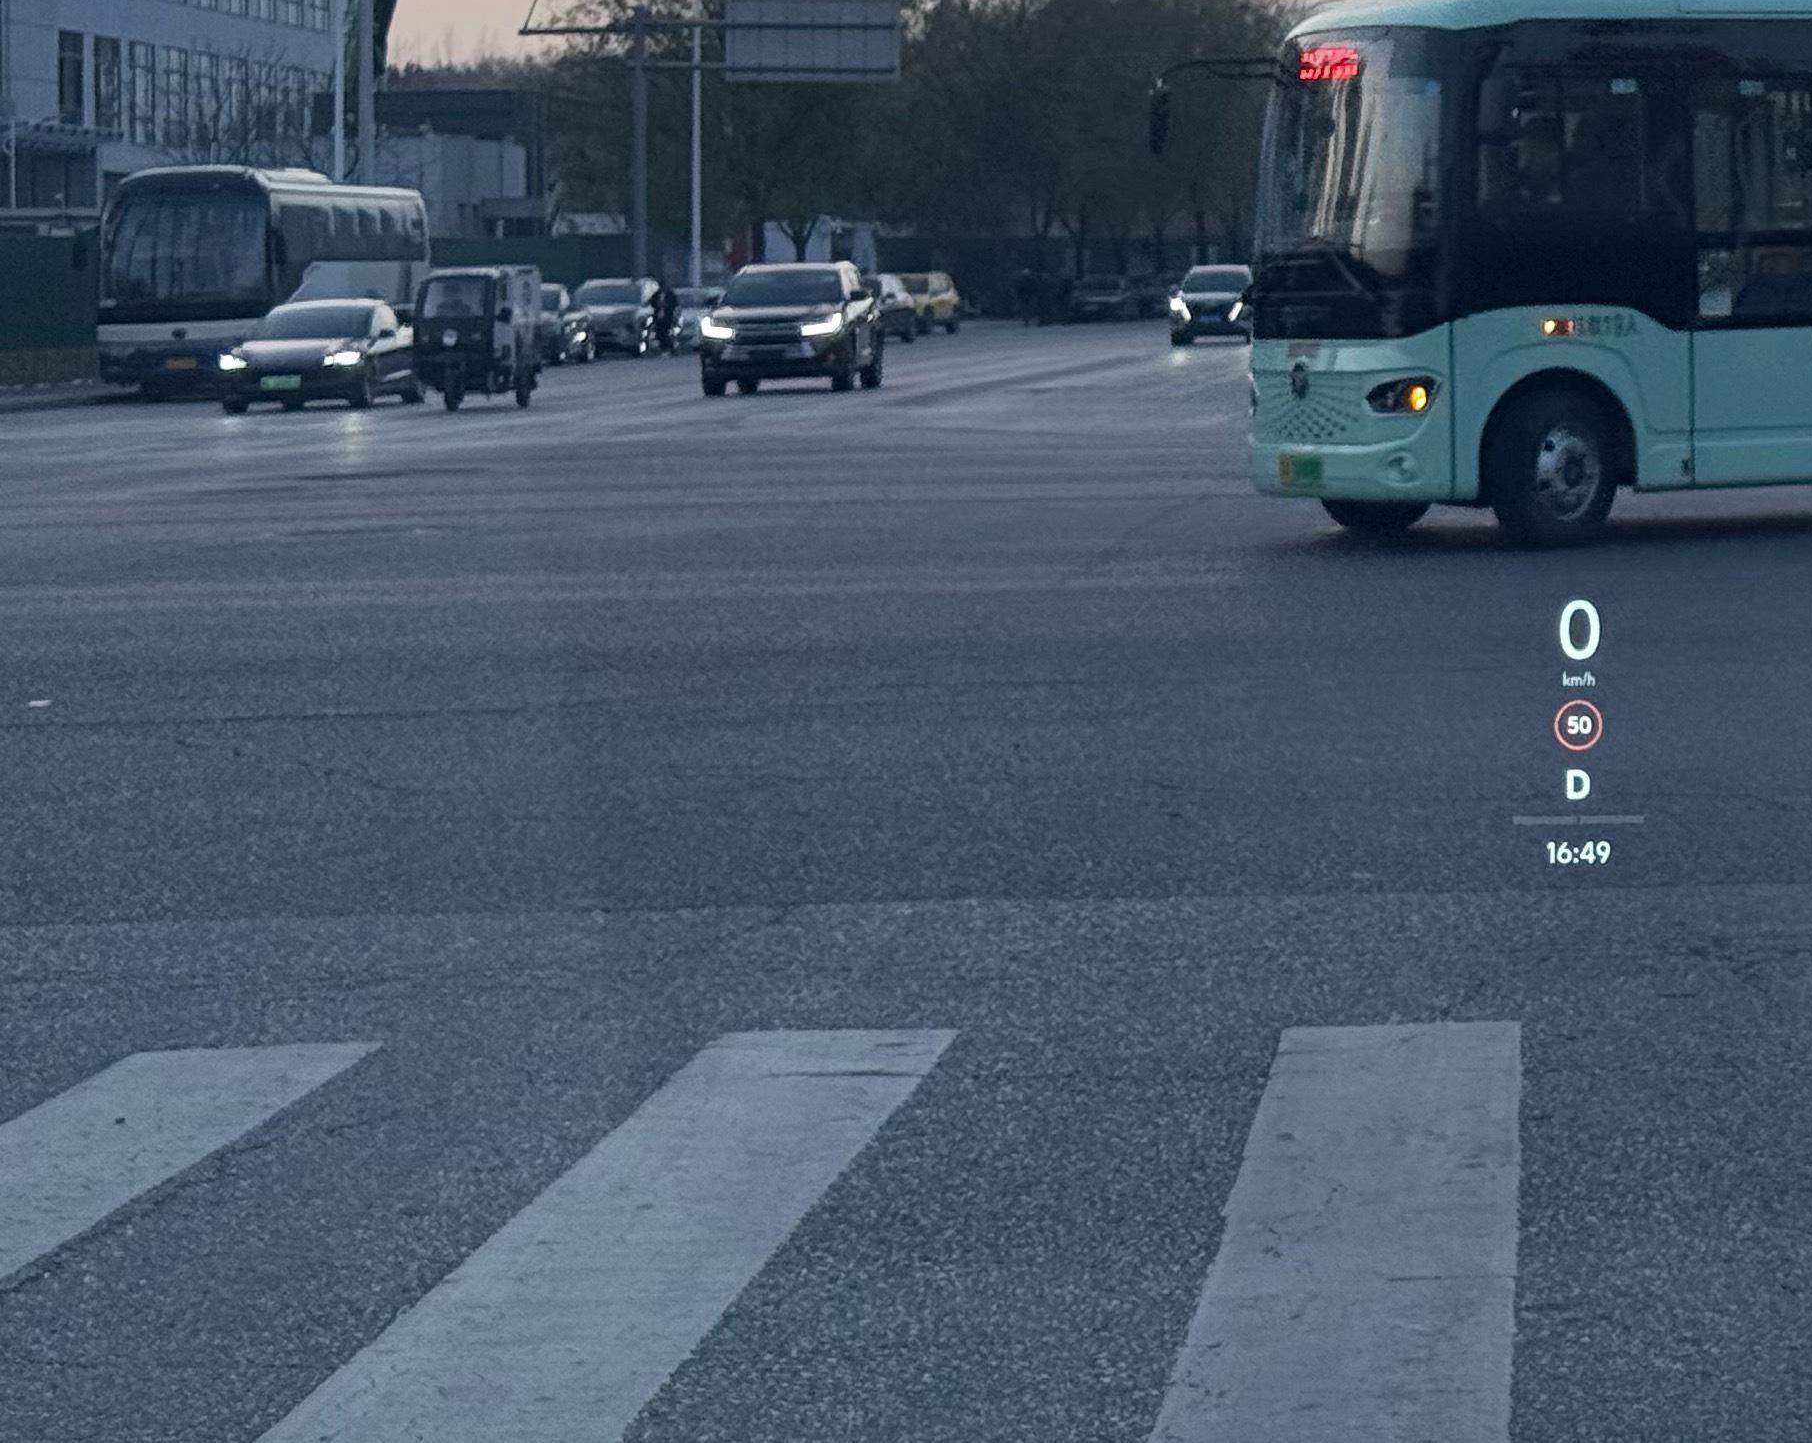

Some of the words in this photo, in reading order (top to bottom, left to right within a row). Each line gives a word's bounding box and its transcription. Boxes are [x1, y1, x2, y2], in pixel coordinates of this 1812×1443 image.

[1559, 599, 1601, 660] 0
[1562, 671, 1596, 687] km/h
[1566, 715, 1593, 735] 50
[1566, 769, 1591, 800] D
[1546, 840, 1611, 864] 16:49
